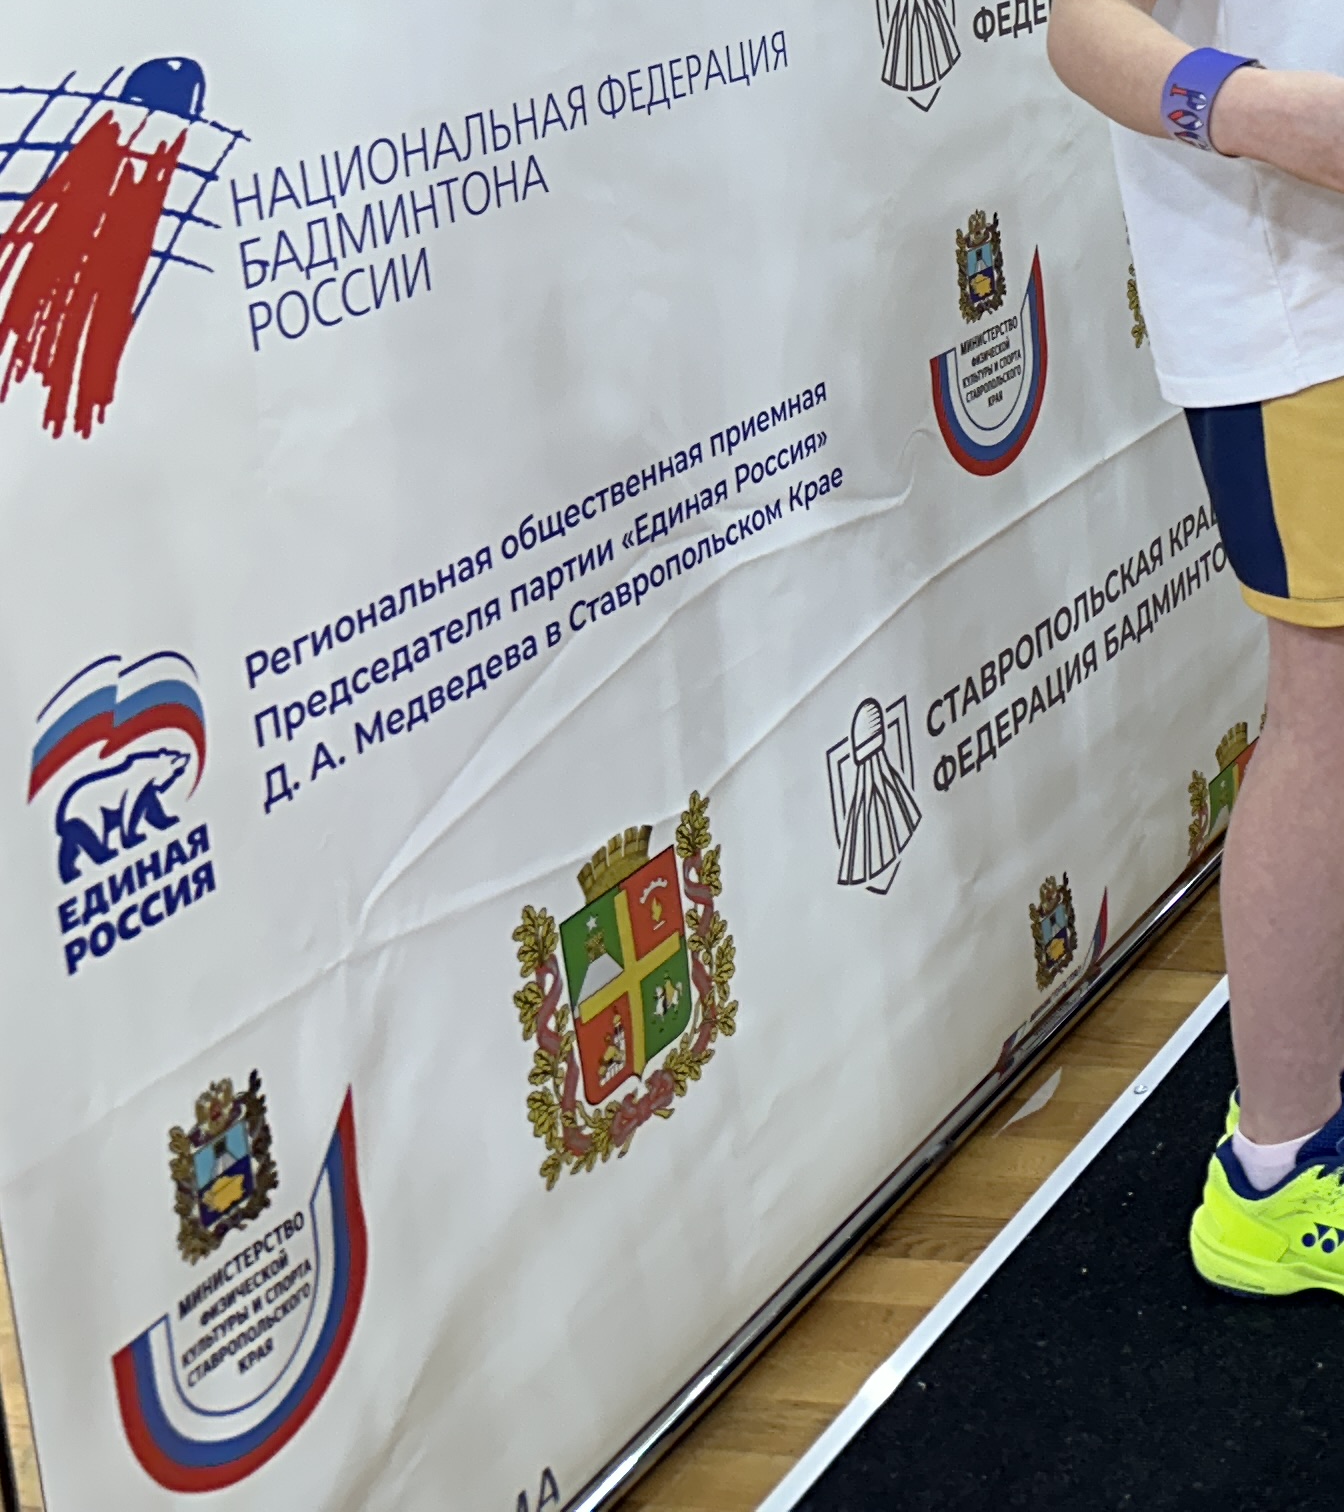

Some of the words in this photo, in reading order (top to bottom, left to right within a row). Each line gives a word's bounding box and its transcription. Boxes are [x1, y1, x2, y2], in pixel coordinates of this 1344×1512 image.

[230, 84, 587, 227] НАЦИОНАЛЬНАЯ
[596, 29, 789, 120] ФЕДЕРАЦИЯ
[239, 153, 549, 289] БАДМИНТОНА
[249, 248, 432, 352] РОССИИ
[243, 542, 493, 688] Региональная
[501, 442, 703, 562] общественная
[709, 380, 827, 466] приемная
[254, 597, 502, 748] Председателя
[509, 539, 614, 619] партии
[620, 477, 728, 558] «Единая
[733, 429, 829, 501] Россия»
[263, 764, 301, 814] Д.
[309, 740, 347, 783] А.
[354, 637, 538, 758] Медведева
[545, 622, 563, 648] в
[568, 500, 783, 635] Ставропольском
[788, 464, 844, 513] Крае
[926, 536, 1164, 737] СТАВРОПОЛЬСКАЯ
[933, 640, 1098, 793] ФЕДЕРАЦИЯ
[57, 823, 212, 935] ЕДИНАЯ
[64, 860, 217, 975] РОССИЯ
[178, 1211, 304, 1320] МИНИСТЕРСТВО
[201, 1248, 289, 1326] ФИЗИЧЕСКОЙ
[252, 1296, 263, 1314] И
[187, 1282, 311, 1388] СТАВРОПОЛЬСКОГО
[238, 1338, 274, 1374] КРАЯ
